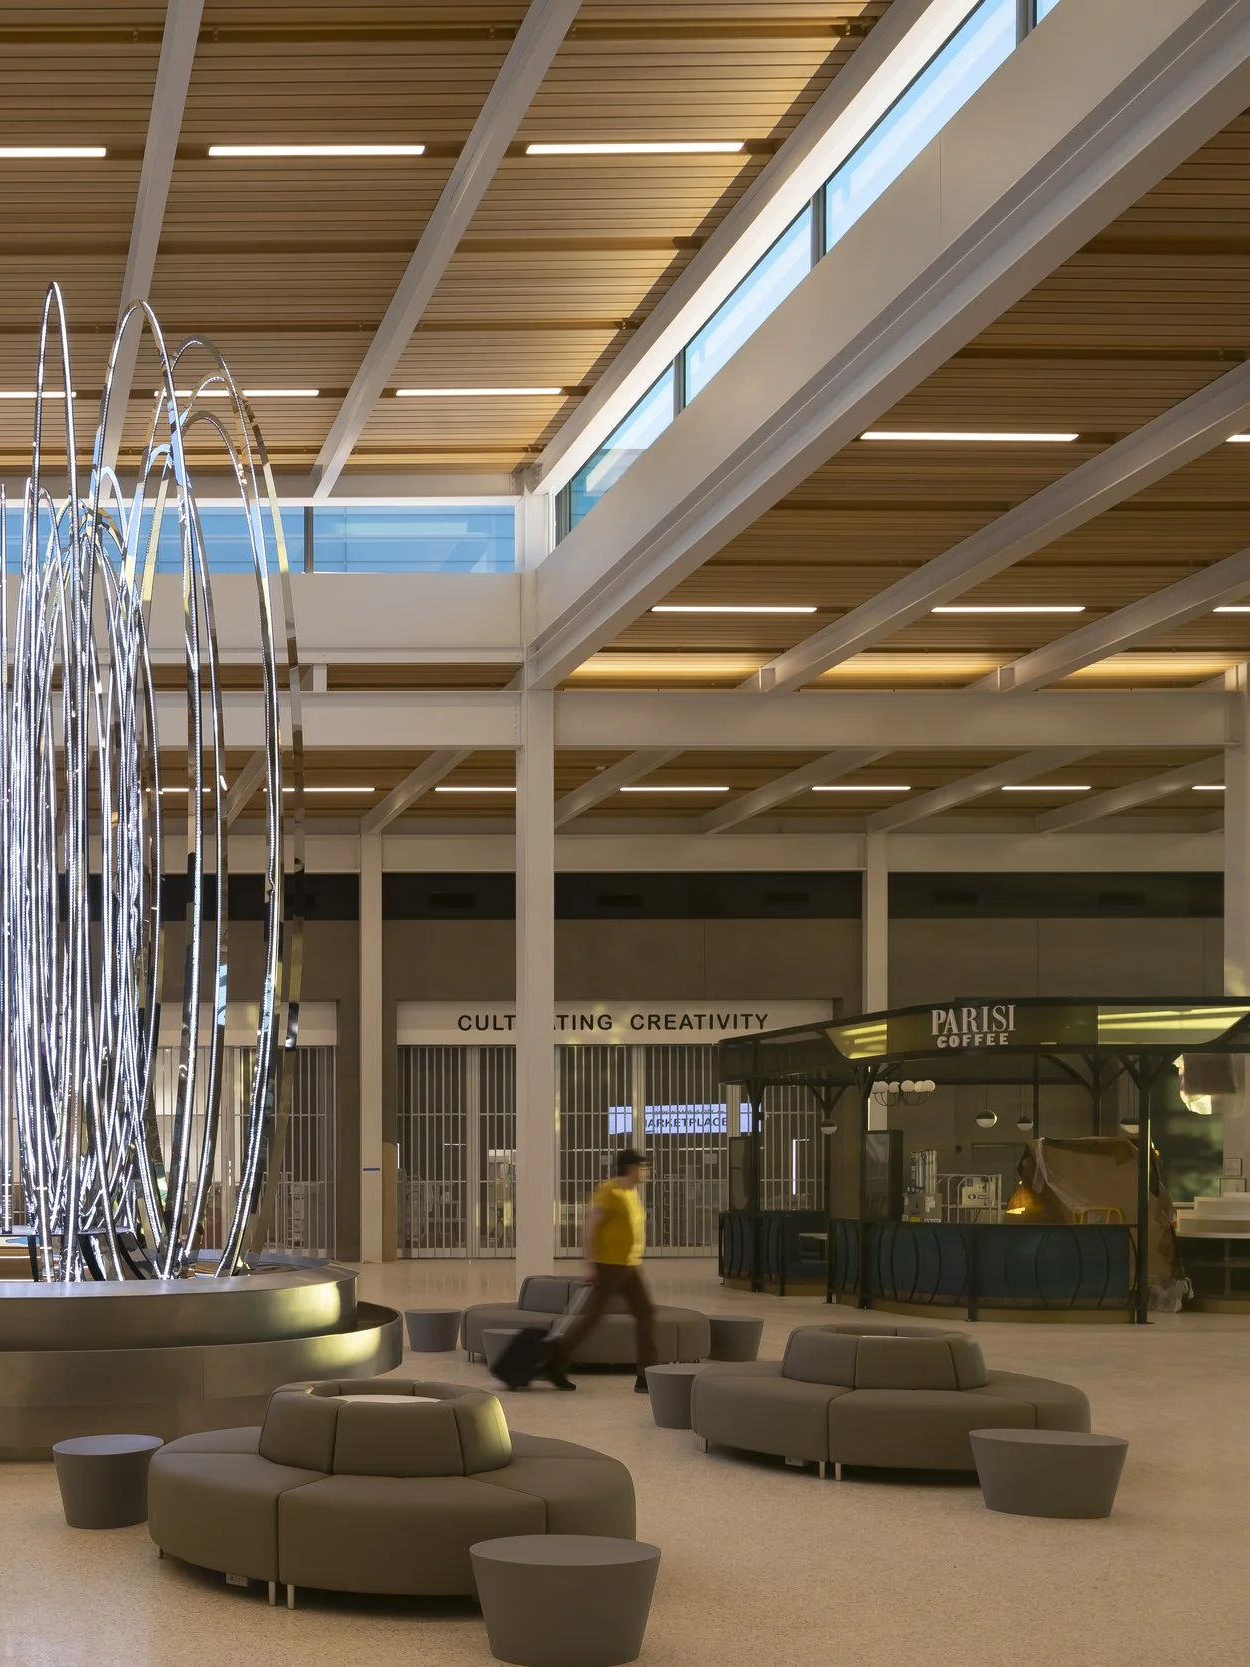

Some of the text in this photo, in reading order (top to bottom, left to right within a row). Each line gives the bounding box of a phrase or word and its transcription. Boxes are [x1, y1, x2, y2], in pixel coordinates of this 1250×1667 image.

[457, 1013, 769, 1031] CULTTING CREATIVITY
[931, 1004, 1016, 1035] PARISI
[936, 1033, 1009, 1049] COFFEE
[645, 1117, 727, 1128] ARKETPLACE
